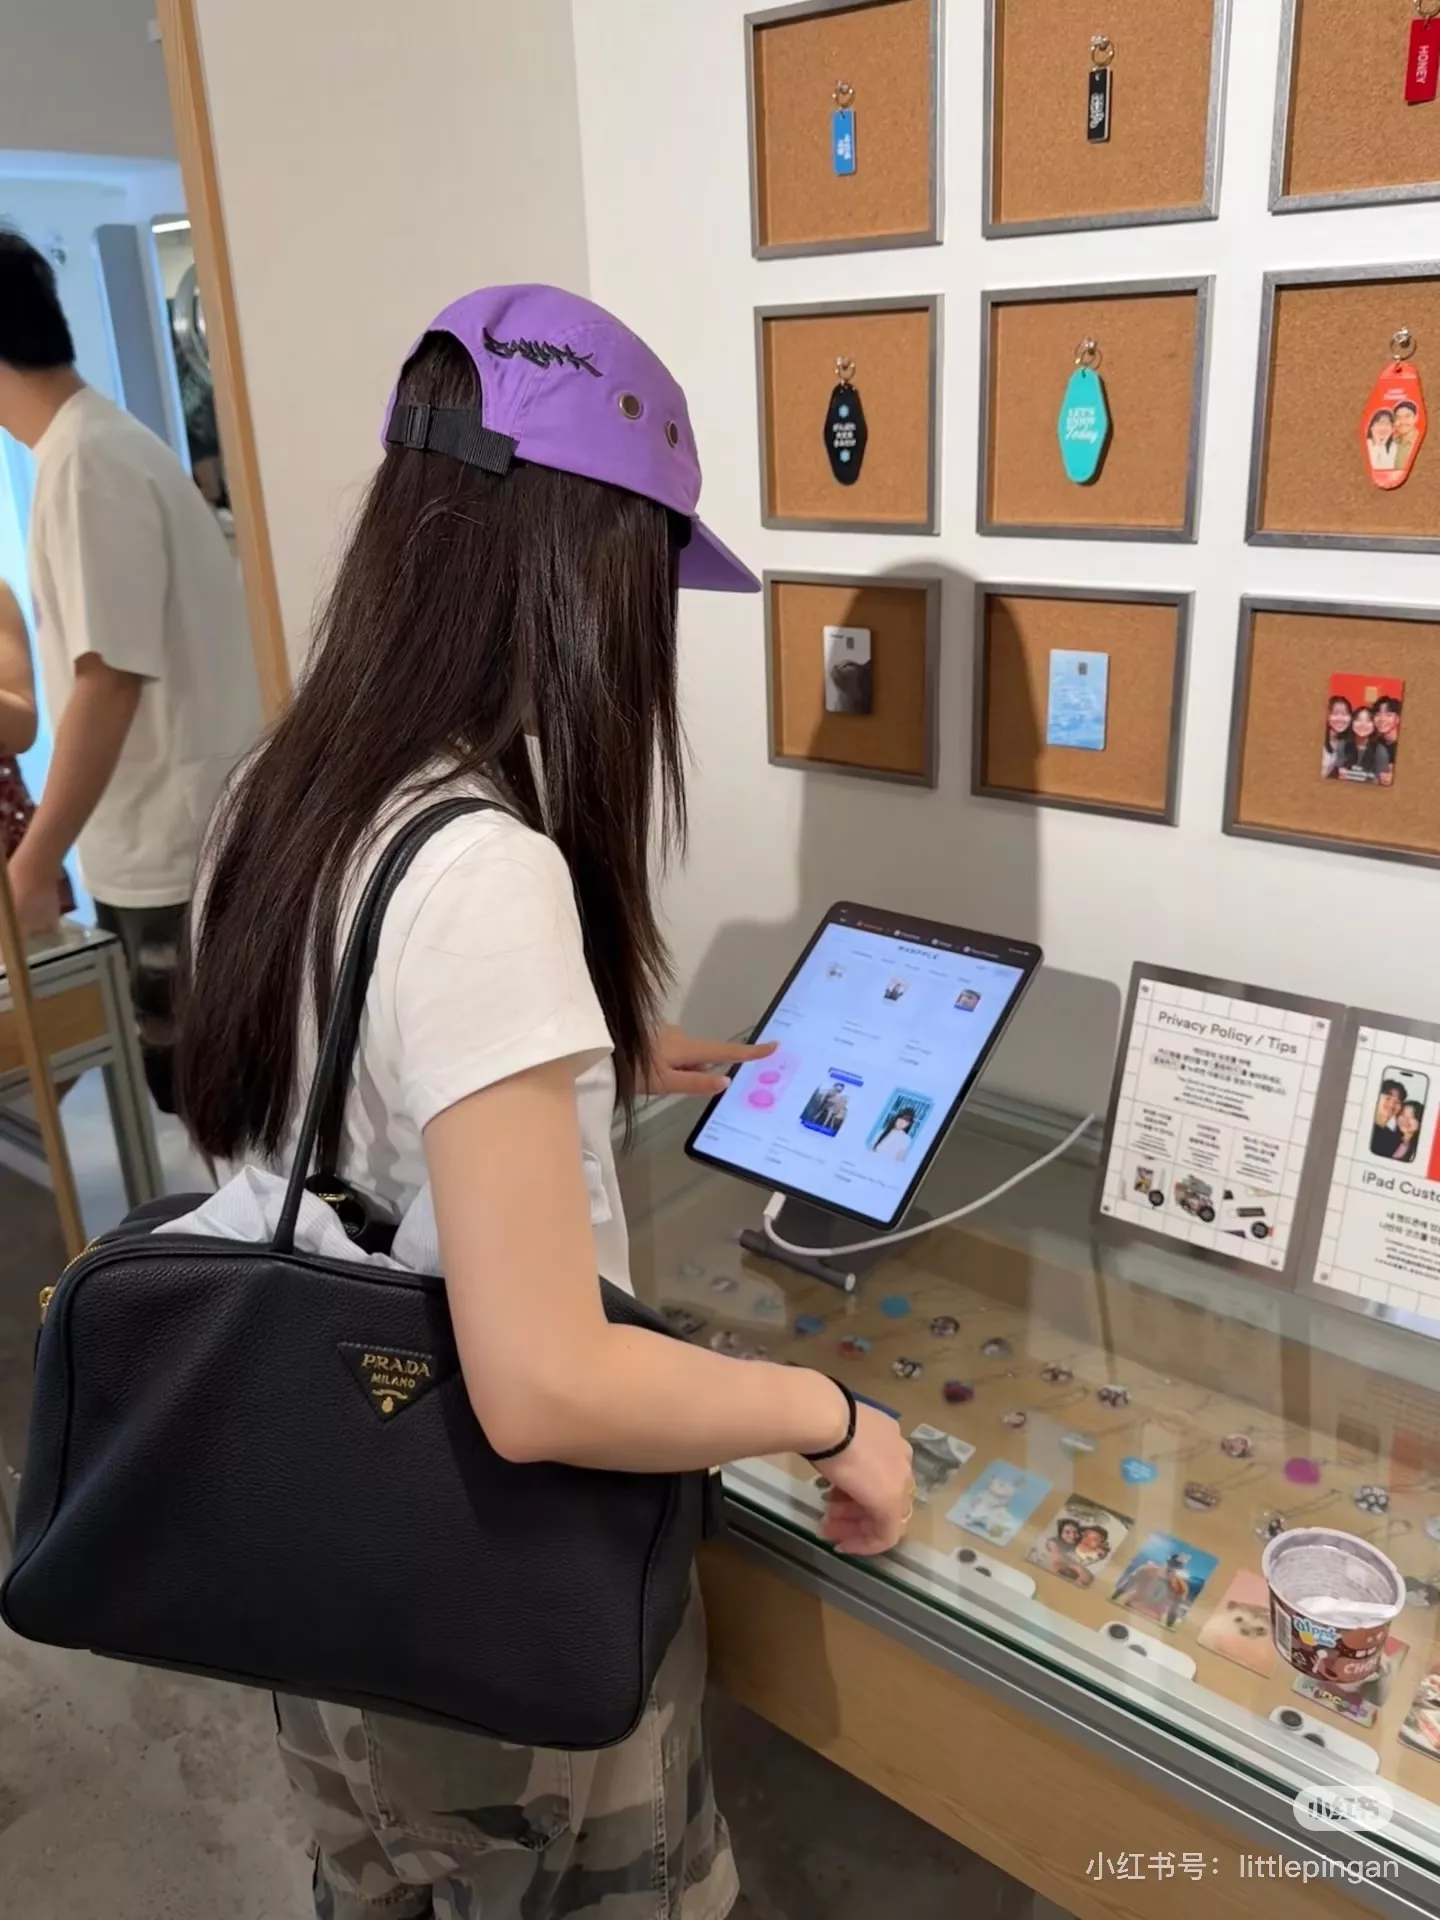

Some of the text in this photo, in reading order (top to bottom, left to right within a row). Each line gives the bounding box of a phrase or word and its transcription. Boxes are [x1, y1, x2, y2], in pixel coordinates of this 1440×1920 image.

[1415, 45, 1430, 84] HONEY
[1158, 1010, 1207, 1036] Privacy
[1210, 1023, 1253, 1046] Policy
[1267, 1036, 1298, 1054] Tips
[1361, 1169, 1396, 1191] iPad
[361, 1353, 431, 1377] PRADA
[371, 1372, 416, 1389] MILANO
